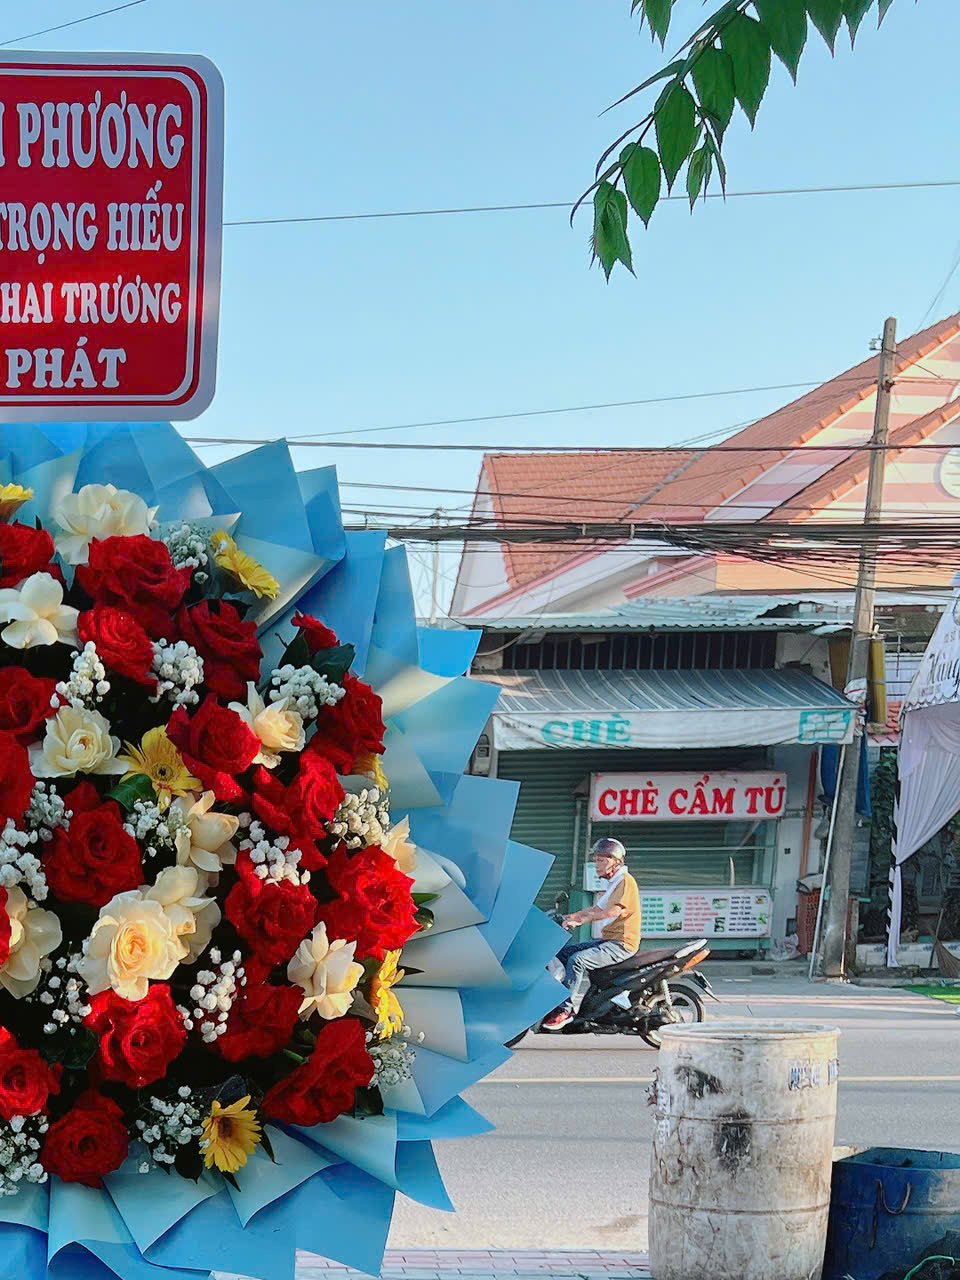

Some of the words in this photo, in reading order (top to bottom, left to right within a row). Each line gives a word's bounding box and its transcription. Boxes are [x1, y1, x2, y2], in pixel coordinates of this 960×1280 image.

[17, 90, 185, 169] PHƯƠNG
[107, 180, 185, 251] HIẾU
[61, 274, 182, 324] TRƯƠNG
[5, 336, 127, 389] PHÁT
[541, 713, 632, 743] CHÈ
[598, 780, 660, 816] CHÈ
[668, 774, 736, 815] CẨM
[744, 778, 785, 815] TÚ
